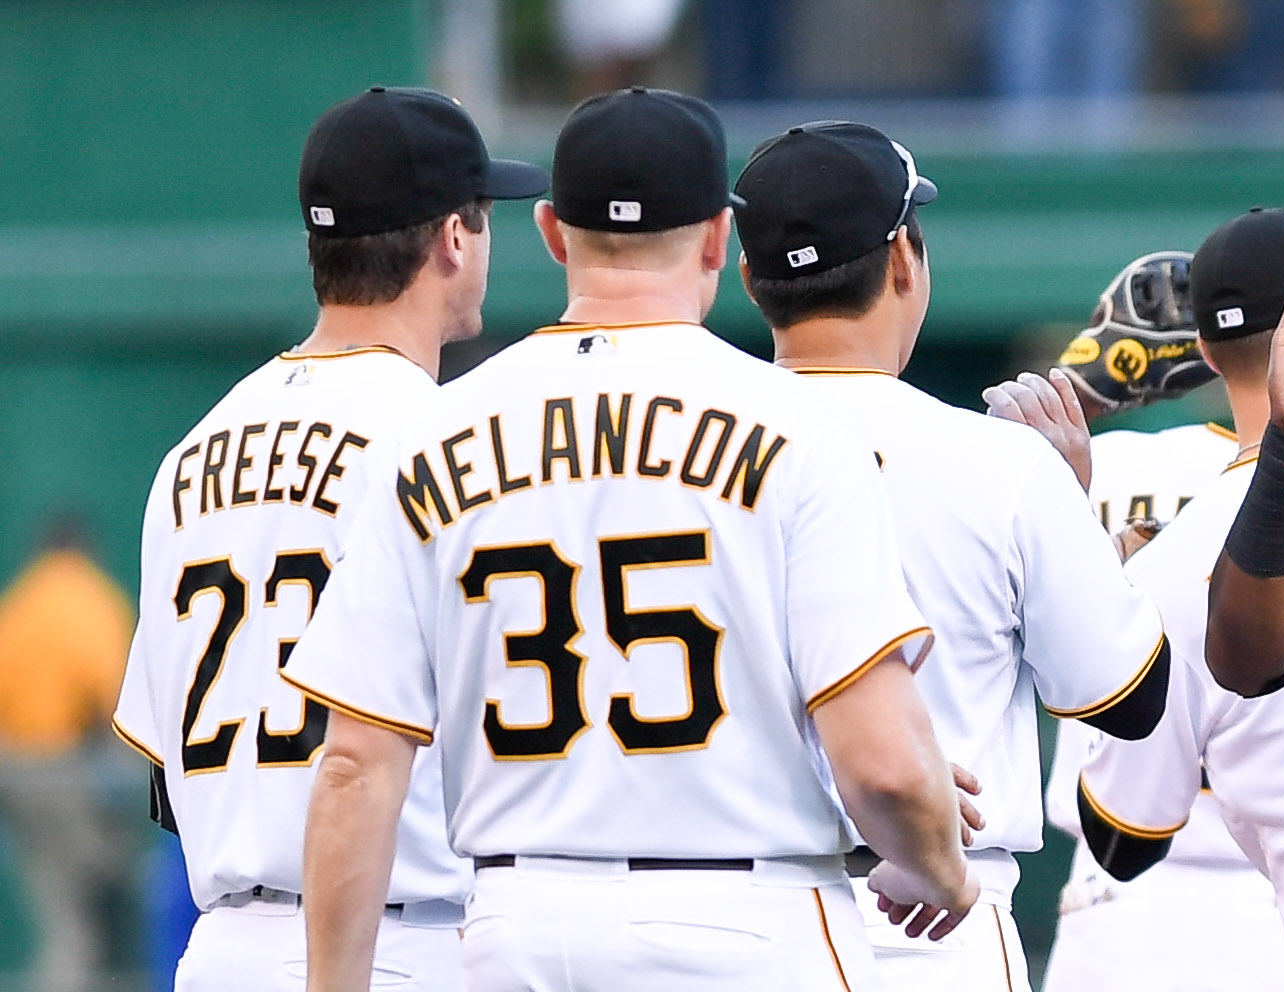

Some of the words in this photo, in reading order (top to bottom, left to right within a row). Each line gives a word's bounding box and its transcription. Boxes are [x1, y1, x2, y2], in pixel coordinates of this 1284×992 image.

[171, 419, 370, 533] FREESE
[394, 391, 789, 545] MELANCON
[456, 528, 730, 763] 35
